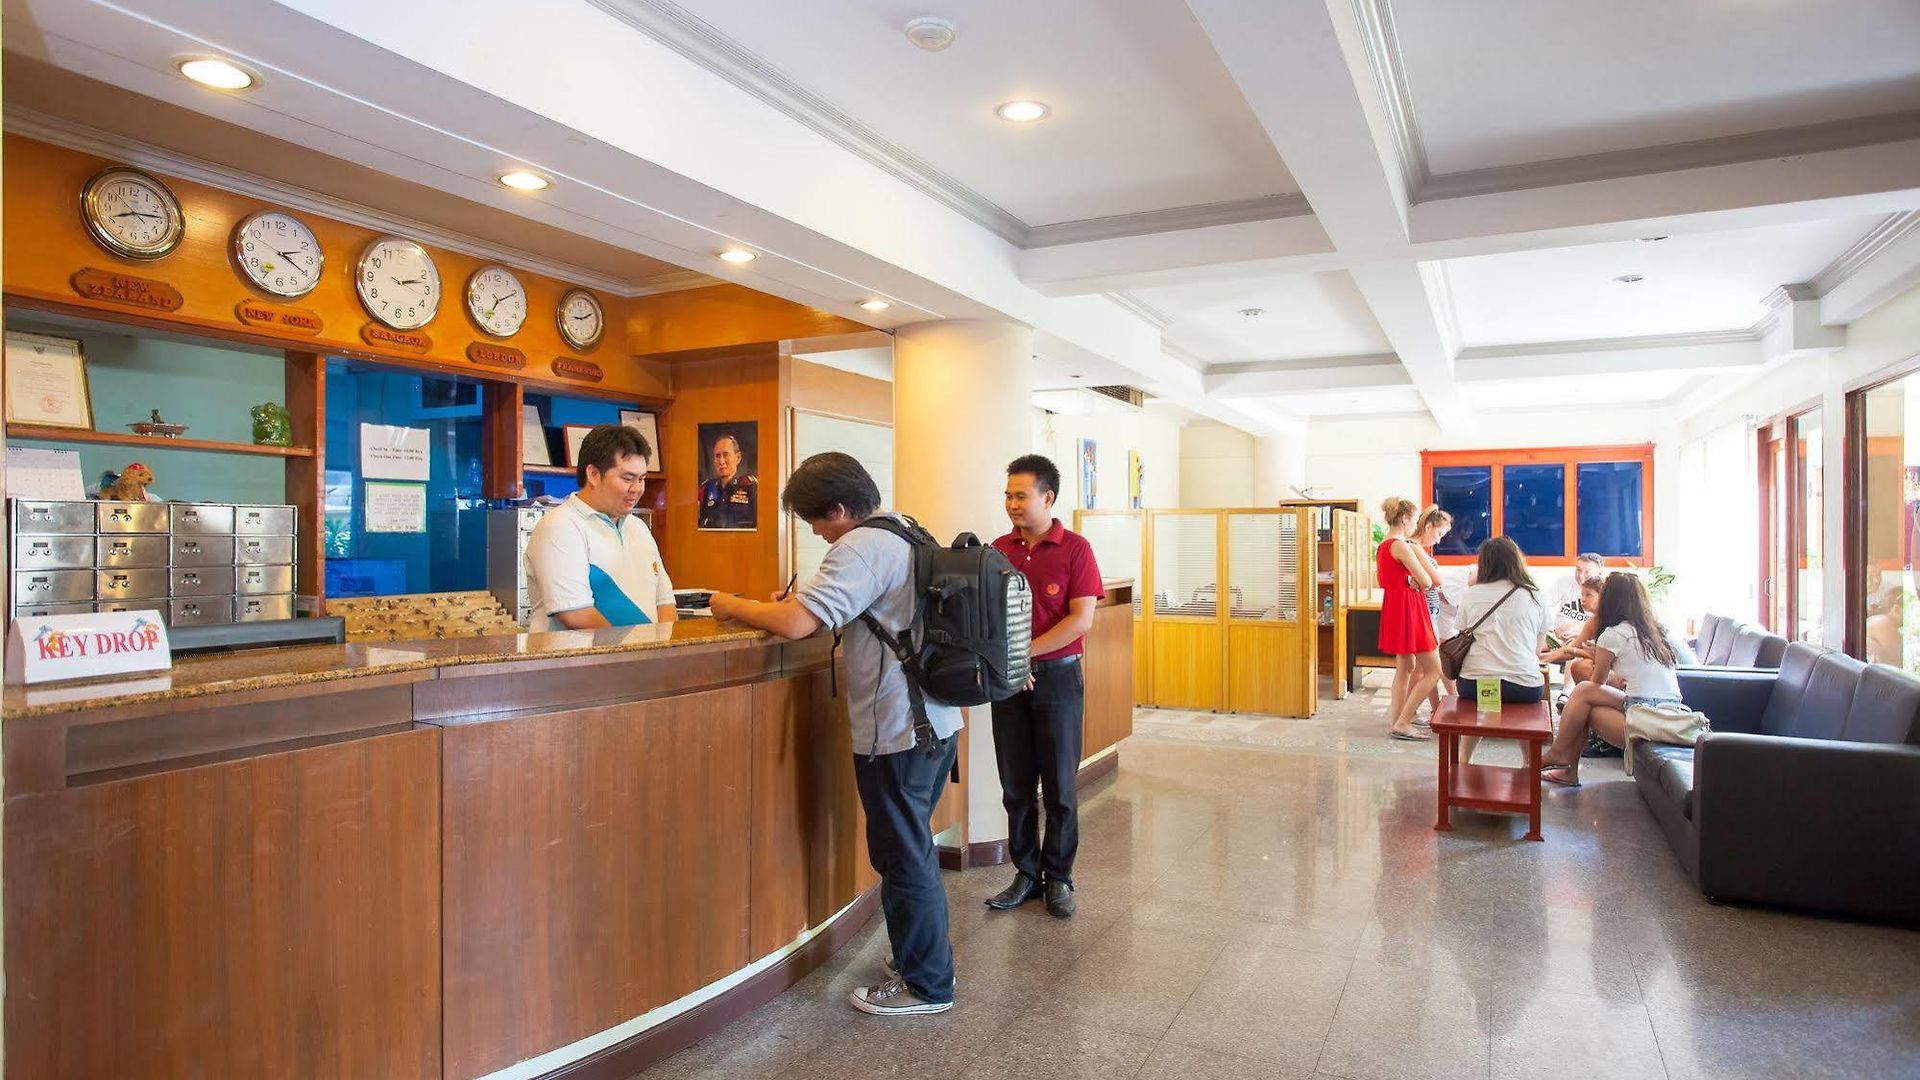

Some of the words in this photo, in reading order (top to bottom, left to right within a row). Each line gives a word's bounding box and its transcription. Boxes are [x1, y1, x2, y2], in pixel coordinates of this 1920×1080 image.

[118, 187, 126, 196] 11
[129, 186, 140, 197] 12
[262, 220, 270, 230] 11
[275, 220, 287, 231] 12
[245, 242, 255, 252] 9
[300, 241, 309, 250] 2
[383, 249, 393, 260] 11
[250, 257, 259, 267] 8
[305, 256, 314, 266] 3
[371, 257, 382, 269] 10
[366, 271, 375, 282] 9
[420, 269, 428, 280] 2
[112, 277, 150, 292] NEW
[275, 277, 284, 287] 6
[289, 276, 298, 286] 5
[89, 283, 173, 306] ZEALAND
[370, 288, 378, 299] 8
[424, 285, 431, 296] 3
[381, 300, 389, 311] 7
[418, 299, 425, 309] 4
[245, 307, 274, 321] NEW
[282, 313, 317, 329] YORK
[394, 308, 402, 319] 6
[408, 307, 416, 318] 5
[370, 329, 426, 348] BANGKOK
[478, 348, 523, 365] LONDON
[37, 634, 88, 660] KEY
[95, 629, 158, 655] DROP
